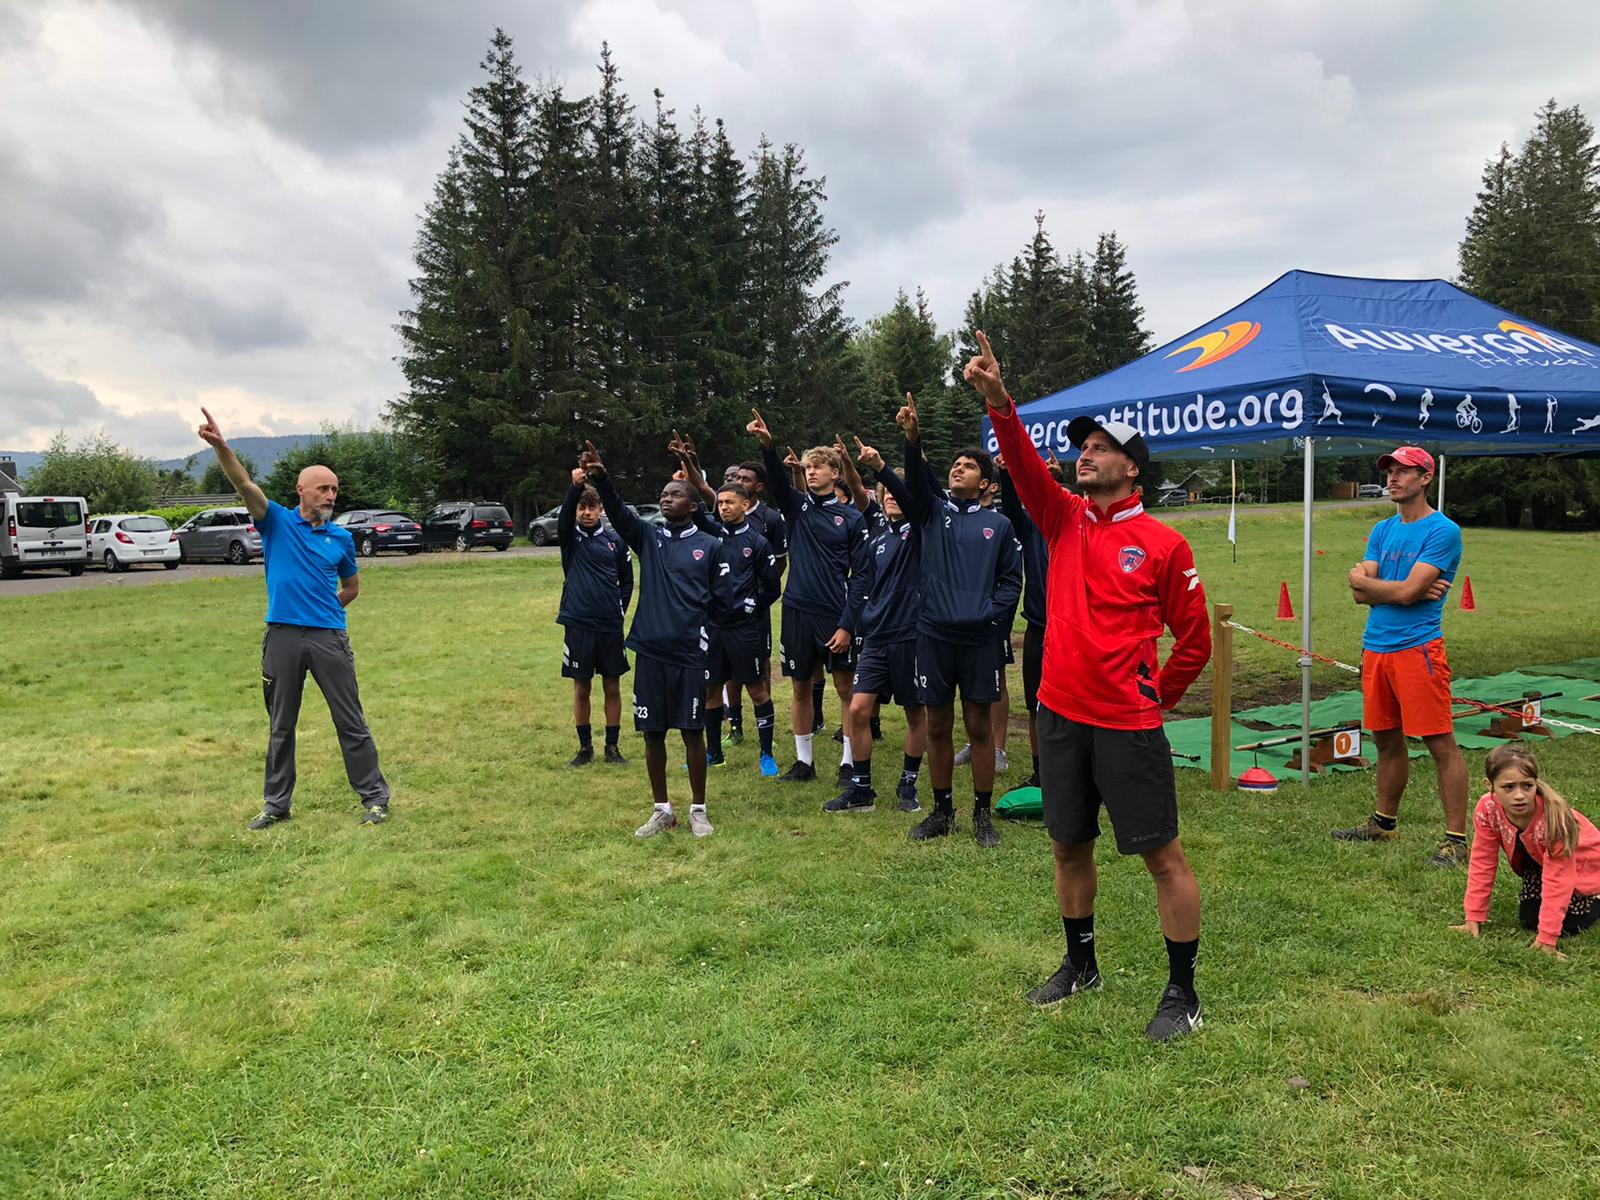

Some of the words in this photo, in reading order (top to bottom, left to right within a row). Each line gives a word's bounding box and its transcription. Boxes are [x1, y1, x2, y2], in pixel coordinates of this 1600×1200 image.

[944, 516, 952, 529] 2
[789, 659, 796, 670] 8
[637, 706, 649, 719] 23
[1340, 737, 1347, 750] 1
